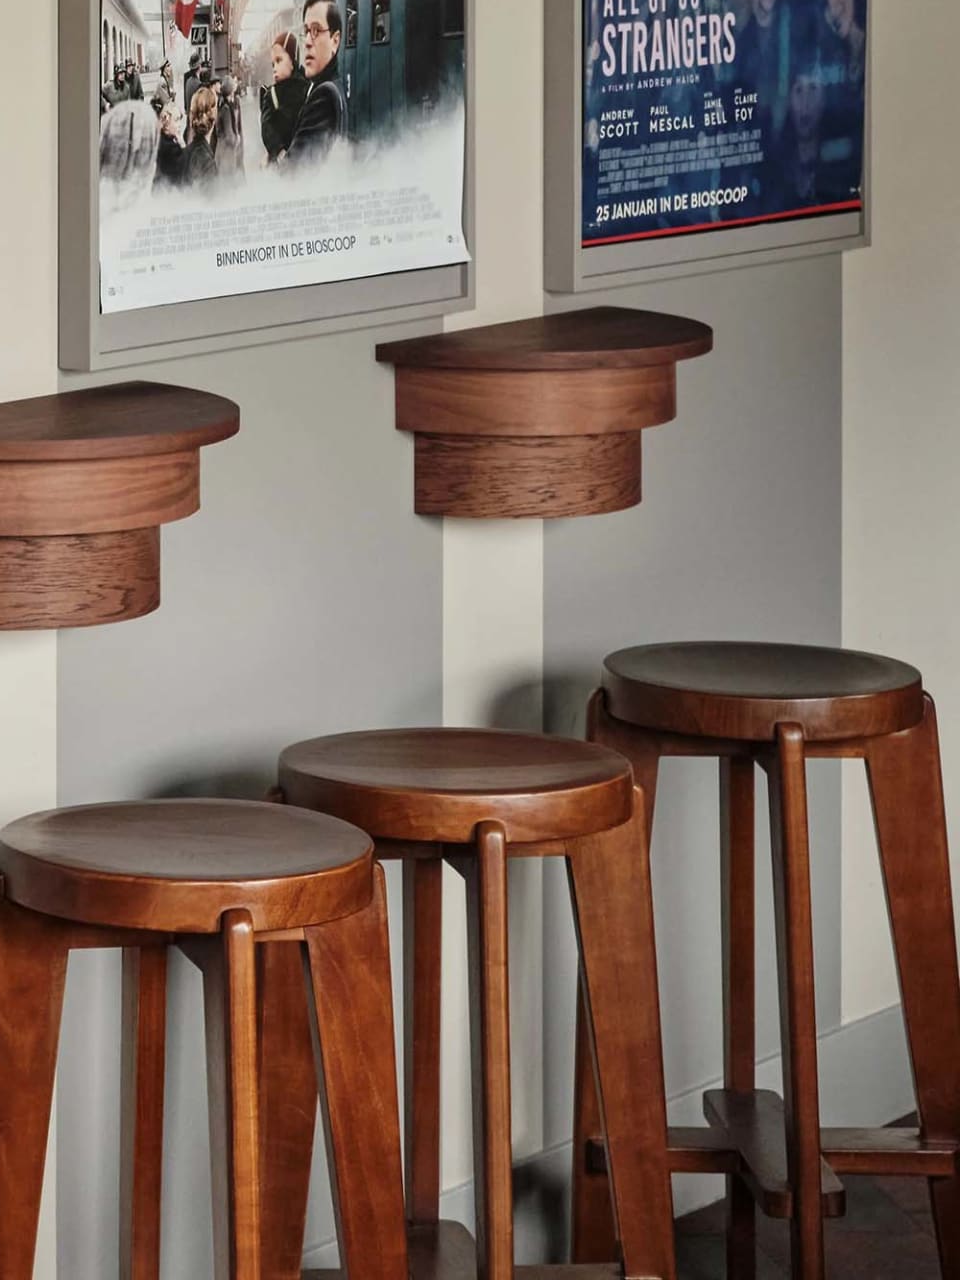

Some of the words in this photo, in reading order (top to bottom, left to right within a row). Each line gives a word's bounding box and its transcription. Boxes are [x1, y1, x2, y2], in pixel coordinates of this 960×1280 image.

[602, 12, 736, 77] STRANGERS
[637, 76, 673, 89] ANDREW
[734, 93, 758, 105] CLAIRE
[601, 109, 635, 121] ANDREW
[650, 105, 669, 116] PAUL
[735, 107, 753, 122] FOY
[649, 116, 695, 133] MESCAL
[704, 111, 727, 126] BELL
[599, 122, 639, 139] SCOTT
[596, 205, 610, 222] 25
[611, 200, 657, 220] JANUARI
[660, 196, 671, 212] IN
[674, 194, 688, 211] DE
[691, 186, 748, 208] BIOSCOOP
[216, 245, 277, 267] BINNENKORT
[278, 244, 289, 259] IN
[291, 242, 304, 257] DE
[306, 235, 356, 255] BIOSCOOP
